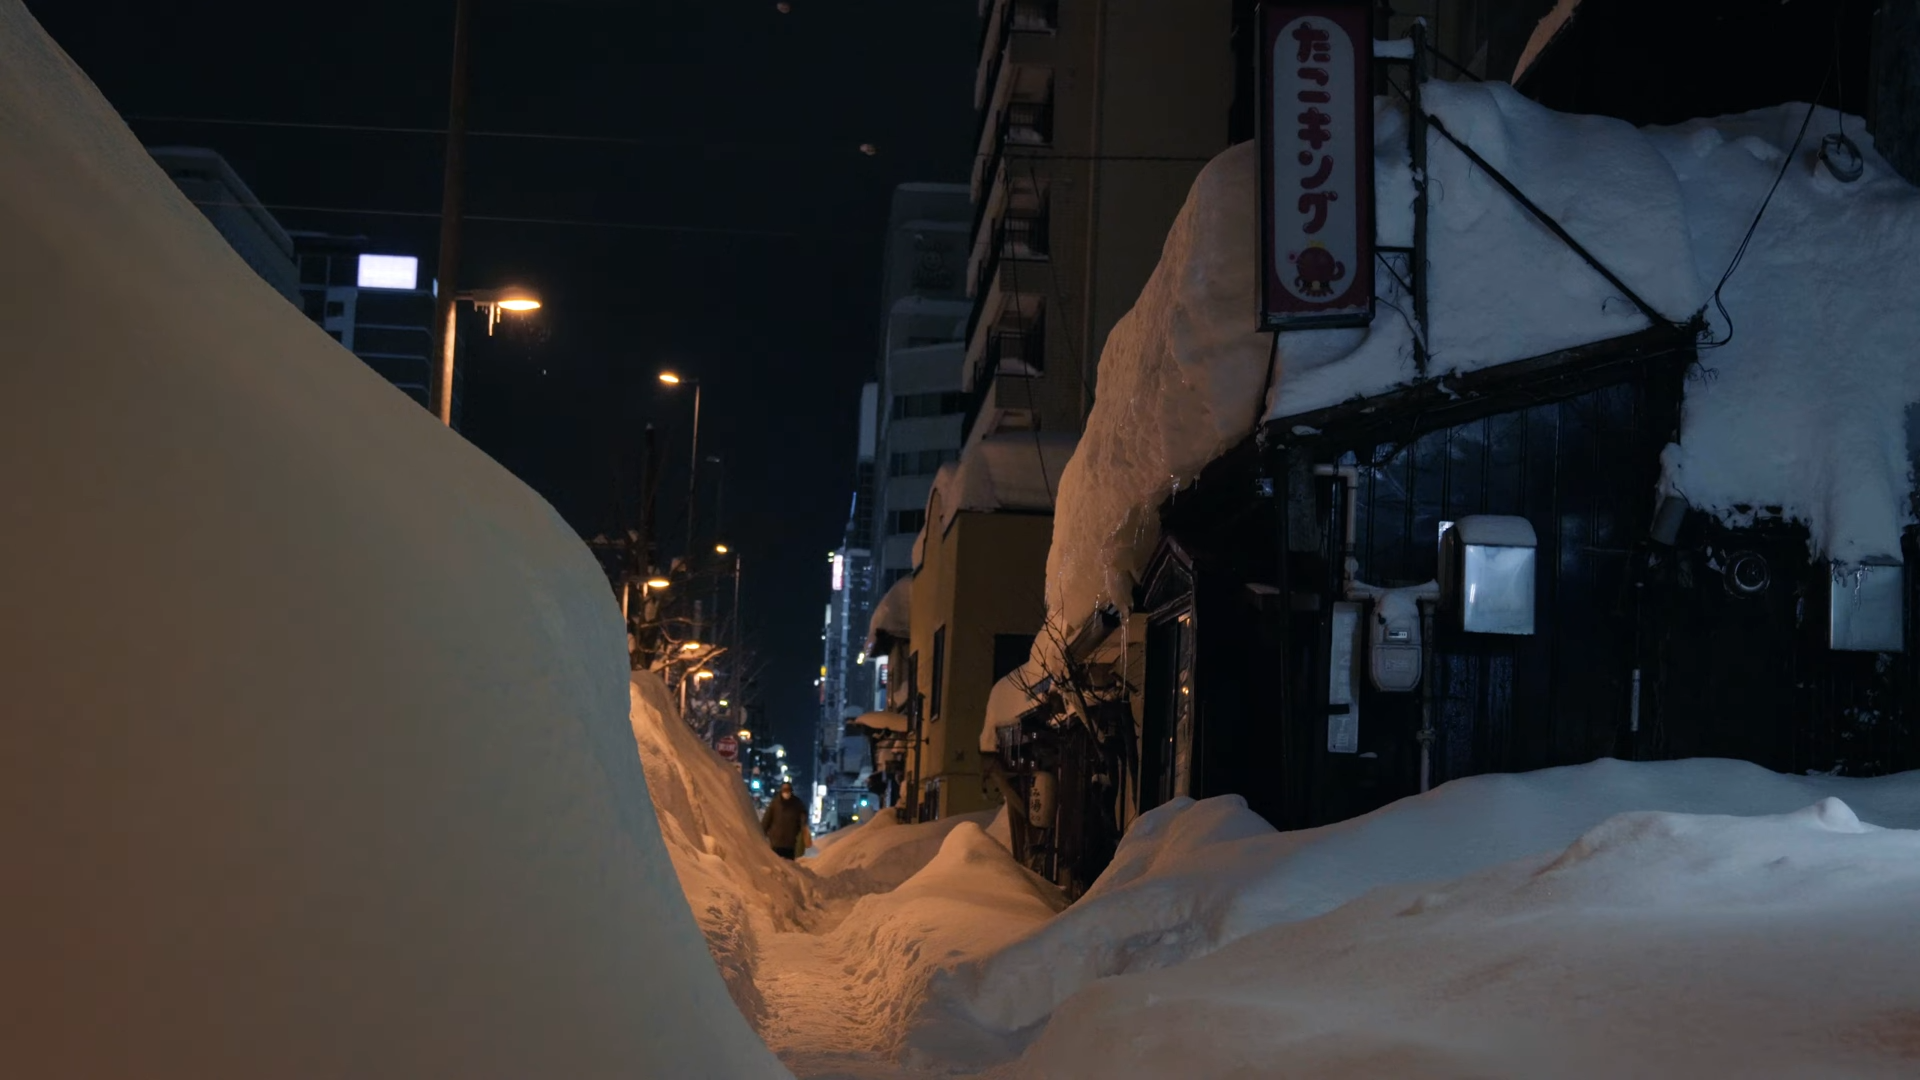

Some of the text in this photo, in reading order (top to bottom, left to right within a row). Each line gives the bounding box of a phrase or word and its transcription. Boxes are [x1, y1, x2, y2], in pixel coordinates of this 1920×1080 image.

[1292, 21, 1338, 235] たこキング
